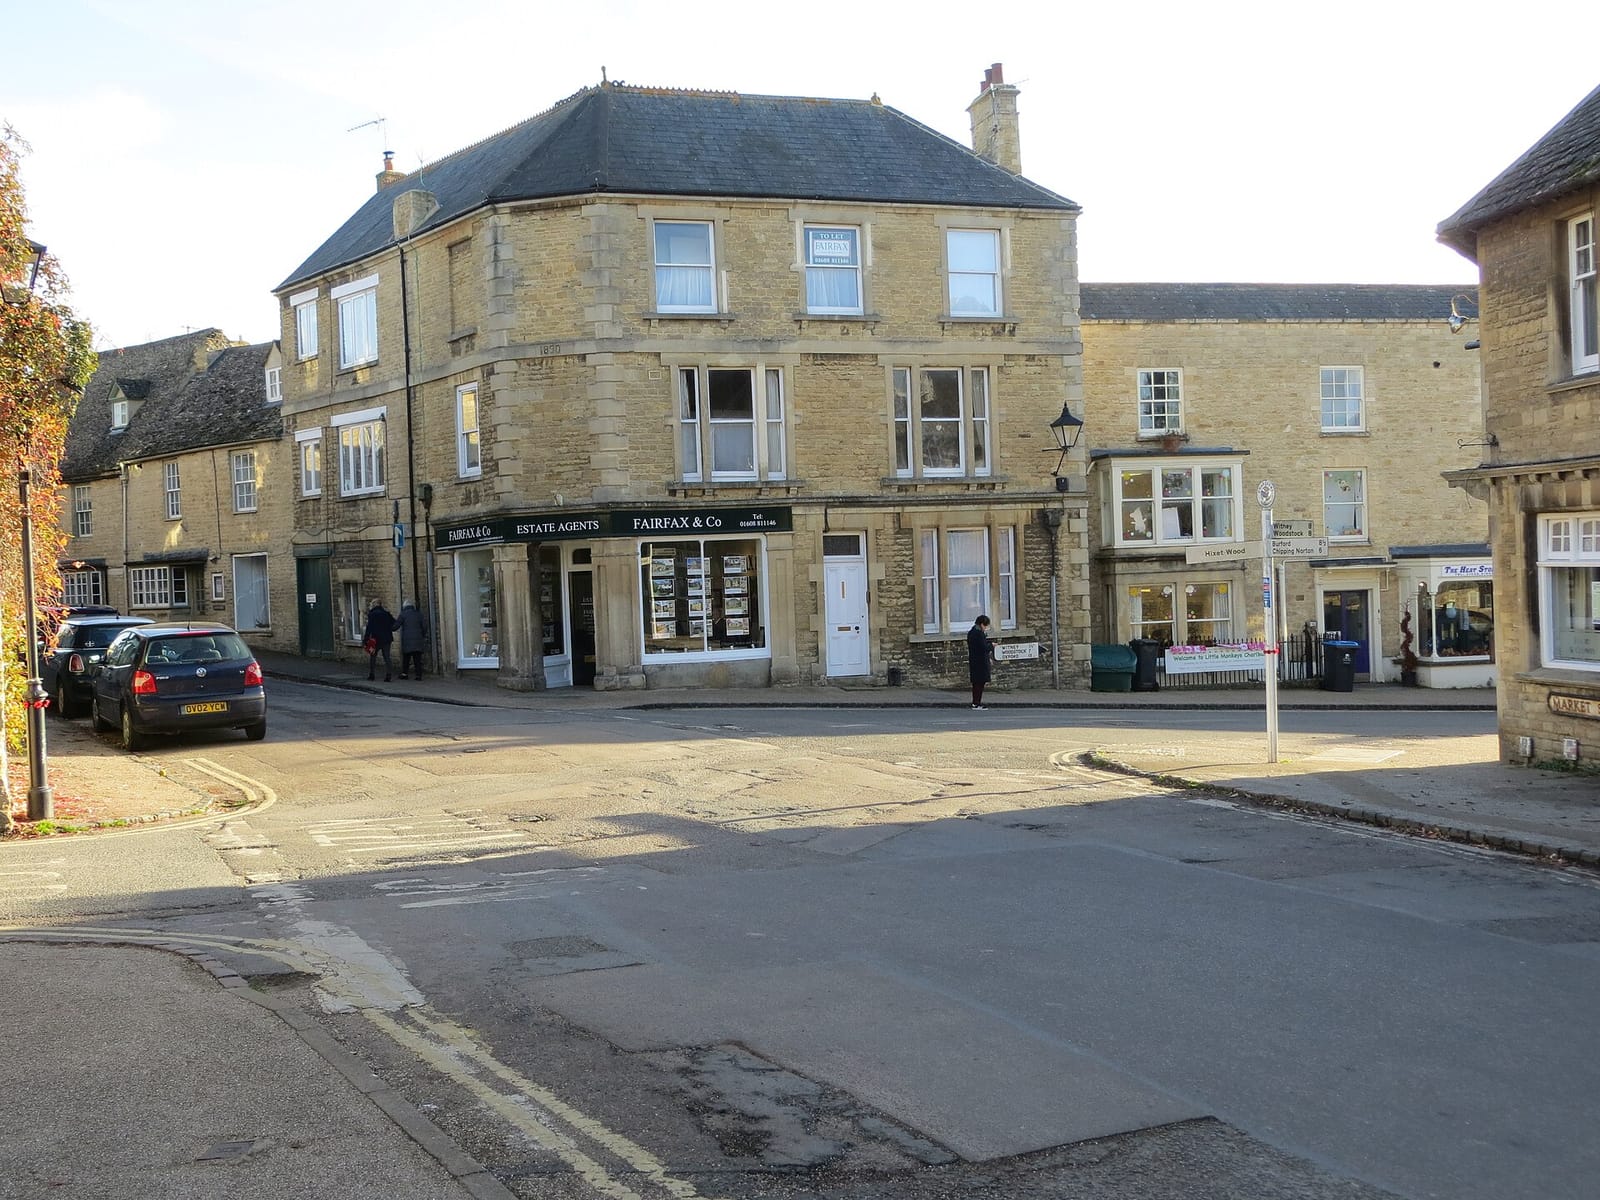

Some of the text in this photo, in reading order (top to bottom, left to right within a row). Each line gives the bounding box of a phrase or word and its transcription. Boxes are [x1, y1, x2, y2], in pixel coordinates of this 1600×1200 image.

[815, 241, 848, 251] FAIRFAX
[517, 520, 600, 534] ESTATE AGENTS
[633, 515, 722, 530] FAIRFAX & Co
[448, 527, 476, 541] FAIRFAX
[475, 527, 482, 538] &
[482, 525, 491, 536] Co
[1226, 548, 1246, 556] Wood
[1272, 547, 1295, 555] Chipping
[1173, 654, 1196, 662] Welcome
[1220, 652, 1243, 660] Monkeys
[1553, 696, 1591, 713] MARKET
